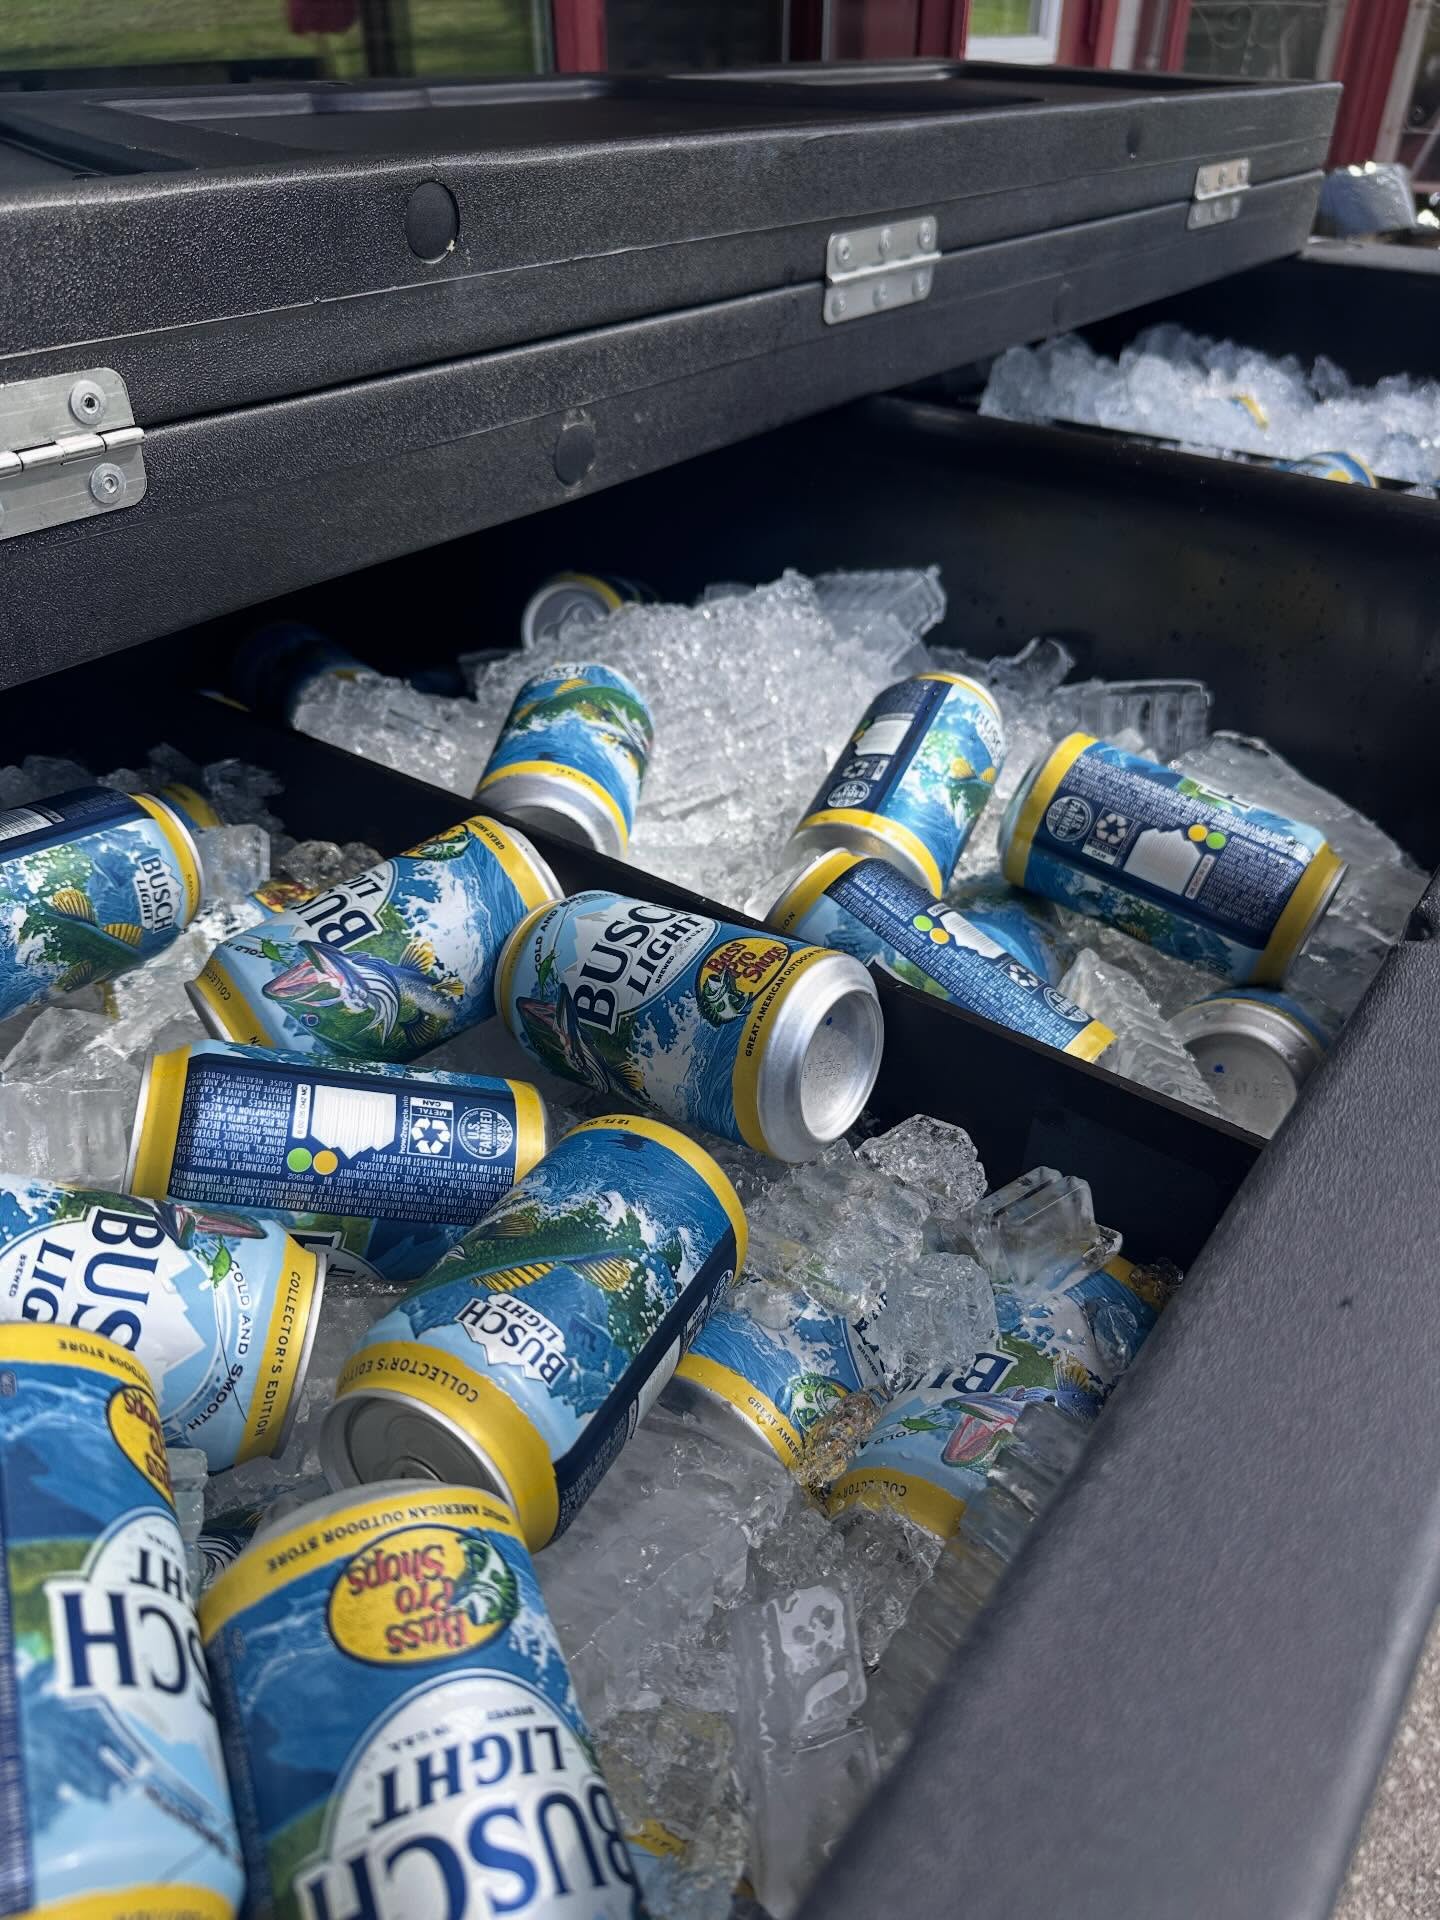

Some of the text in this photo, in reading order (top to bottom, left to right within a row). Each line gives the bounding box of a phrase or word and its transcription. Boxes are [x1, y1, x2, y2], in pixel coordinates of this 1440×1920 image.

[141, 856, 172, 932] BUSCH
[137, 880, 153, 921] LIGHT
[541, 909, 558, 933] AND
[626, 916, 702, 996] LIGHT
[704, 942, 747, 975] Bass
[573, 903, 690, 1031] BUSC
[654, 955, 676, 984] BREWED
[728, 951, 757, 979] Pro
[742, 946, 787, 984] Shops
[745, 1022, 761, 1057] GREAT
[756, 976, 788, 1022] AMERICAN
[783, 950, 815, 977] OUTDOOR
[204, 1079, 218, 1087] AND
[235, 1075, 263, 1085] HEALTH
[269, 1079, 292, 1088] CAUSE
[199, 1086, 214, 1094] CAR
[224, 1089, 246, 1097] DRIVE
[263, 1086, 291, 1094] OPERATE
[185, 1092, 290, 1110] BEVERAGES IMPAIRS YOUR
[263, 1093, 291, 1102] ABILITY
[421, 1099, 441, 1107] CAN
[183, 1101, 222, 1112] ALCOHOLIC
[416, 1106, 447, 1117] METAL
[228, 1114, 247, 1123] BIRTH
[239, 1107, 289, 1119] CONSUMPTION
[191, 1119, 220, 1129] BECAUSE
[259, 1117, 274, 1126] RISK
[275, 1119, 288, 1128] THE
[398, 1095, 411, 1153] how2recycle.info
[222, 1122, 261, 1133] PREGNANCY
[262, 1126, 287, 1136] DURING
[466, 1120, 481, 1139] U.S.
[478, 1110, 494, 1155] FARMED
[179, 1127, 286, 1146] DRINK ALCOHOLIC BEVERAGES
[178, 1136, 284, 1155] GENERAL, WOMEN SHOULD NOT
[176, 1145, 283, 1164] ACCORDING TO THE SURGEON
[371, 1153, 387, 1162] DATE
[388, 1155, 410, 1164] BEFORE
[188, 1156, 227, 1168] WARNING:
[231, 1160, 281, 1174] GOVERNMENT
[355, 1161, 403, 1173] 1-877-BUSCH52
[412, 1157, 441, 1167] FRESHEST
[443, 1160, 454, 1168] FOR
[456, 1162, 468, 1170] CAN
[339, 1168, 377, 1179] RESPONSIBLY
[405, 1166, 420, 1174] CALL
[421, 1168, 489, 1181] QUESTIONS/COMMENTS
[478, 1164, 501, 1174] BOTTOM
[231, 1175, 260, 1186] CALORIES,
[287, 1172, 314, 1182] 881902
[335, 1177, 353, 1186] LOUIS,
[377, 1172, 396, 1181] ENJOY
[205, 1182, 235, 1193] SUPPORTER
[262, 1178, 289, 1189] ANALYSIS:
[289, 1181, 314, 1192] AVERAGE
[206, 1191, 231, 1201] RIGHTS
[236, 1186, 254, 1195] PROUD
[306, 1202, 352, 1213] INTELLECTUAL
[354, 1206, 366, 1214] PRO
[367, 1207, 384, 1216] BASS
[397, 1210, 433, 1220] TRADEMARK
[9, 1254, 28, 1298] BREWED
[496, 1299, 560, 1342] LIGHT
[187, 1260, 252, 1431] COLD AND SMOOTH
[457, 1299, 568, 1387] BUSCH
[57, 1338, 105, 1360] STORE
[254, 1270, 301, 1437] COLLECTOR'S EDITION
[857, 1343, 880, 1377] BREWED
[375, 1357, 480, 1403] COLLECTOR'S
[747, 1396, 778, 1427] GREAT
[266, 1503, 479, 1573] AMERICAN OUTDOOR STORE
[347, 1543, 446, 1597] Shops
[395, 1575, 456, 1615] Pro
[384, 1611, 469, 1656] Bass
[369, 1725, 566, 1831] LIGHT
